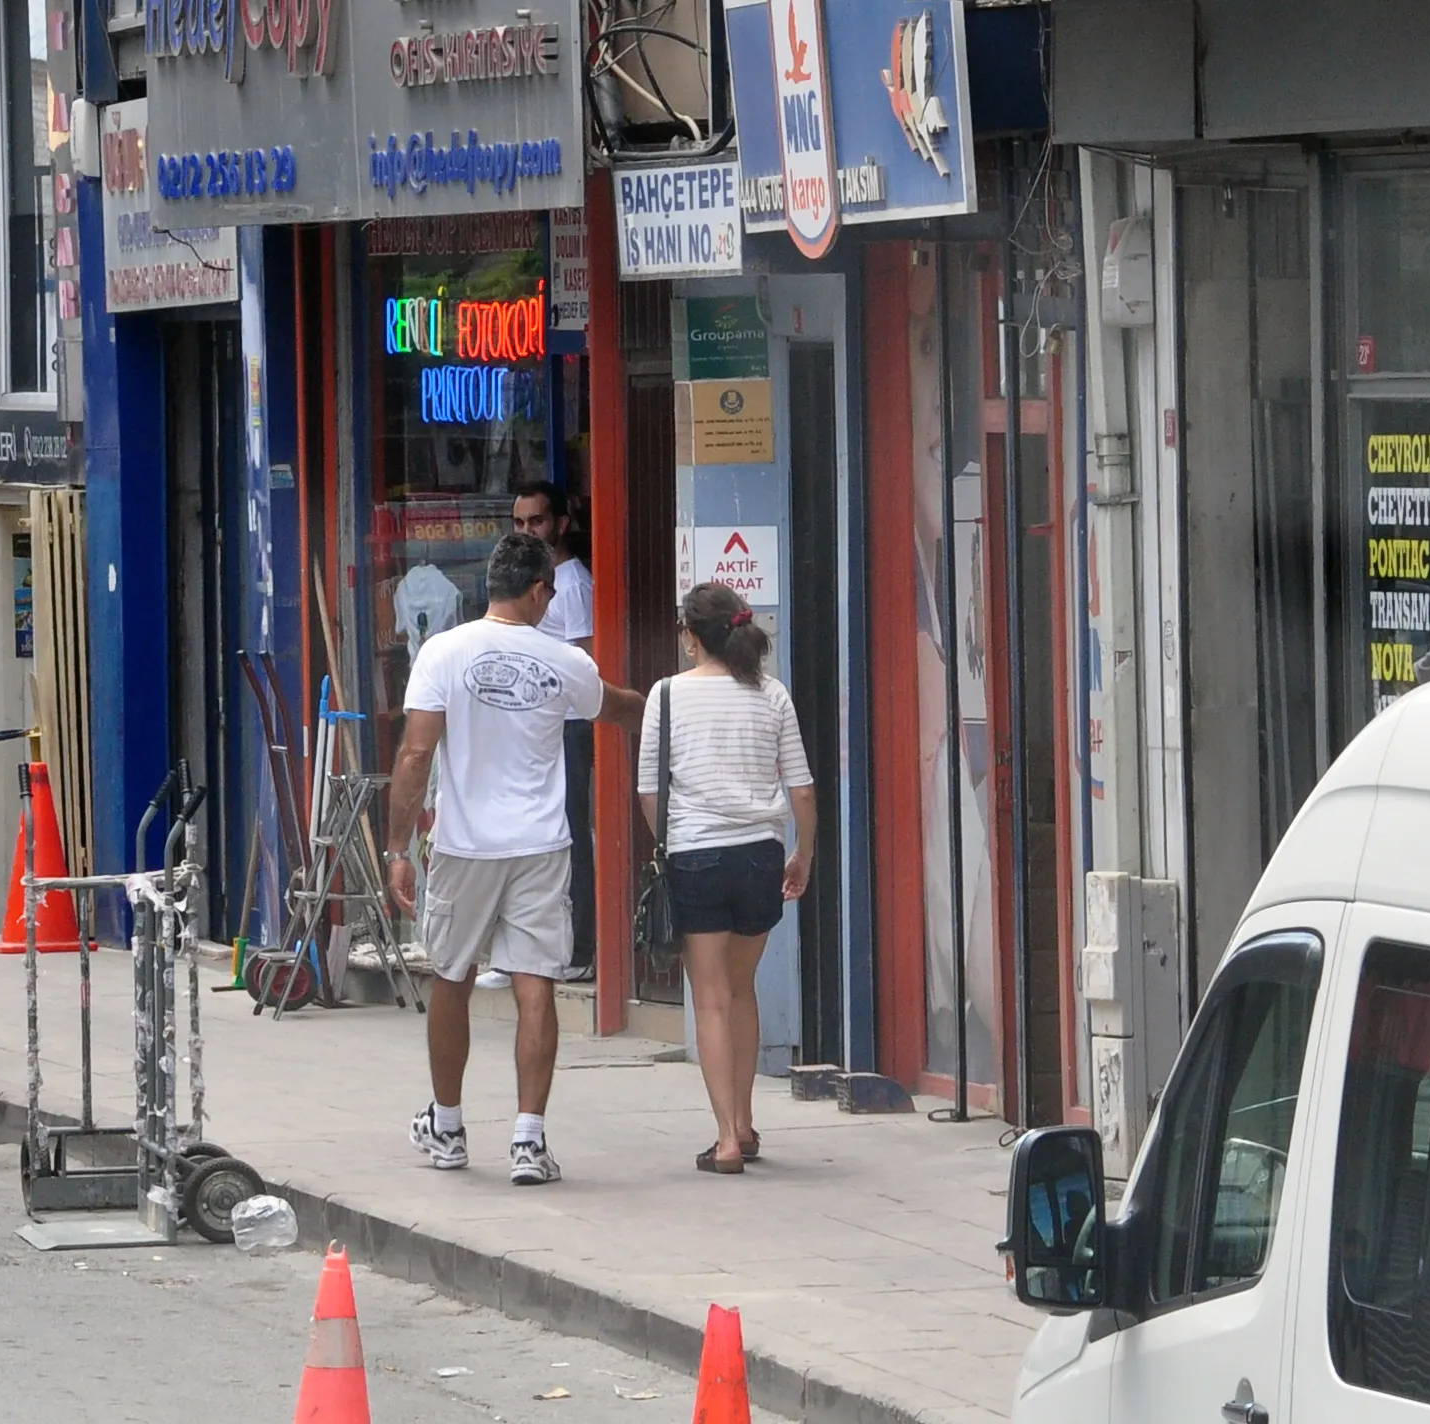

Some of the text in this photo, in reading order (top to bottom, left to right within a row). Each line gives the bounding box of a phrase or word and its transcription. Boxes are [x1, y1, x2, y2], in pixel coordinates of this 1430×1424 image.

[783, 90, 821, 154] MNG
[621, 168, 734, 218] BAHÇETEPE
[790, 169, 826, 221] kargo
[838, 156, 881, 204] TAKSİM
[644, 224, 683, 266] HANI
[457, 279, 545, 362] FOTOKOPİ
[690, 328, 765, 342] Groupama
[421, 364, 509, 425] PRINTOUT
[714, 557, 759, 573] AKTİF
[1369, 539, 1430, 579] PONTIAC
[1370, 591, 1430, 631] TRANSAM
[1371, 643, 1415, 682] NOVA
